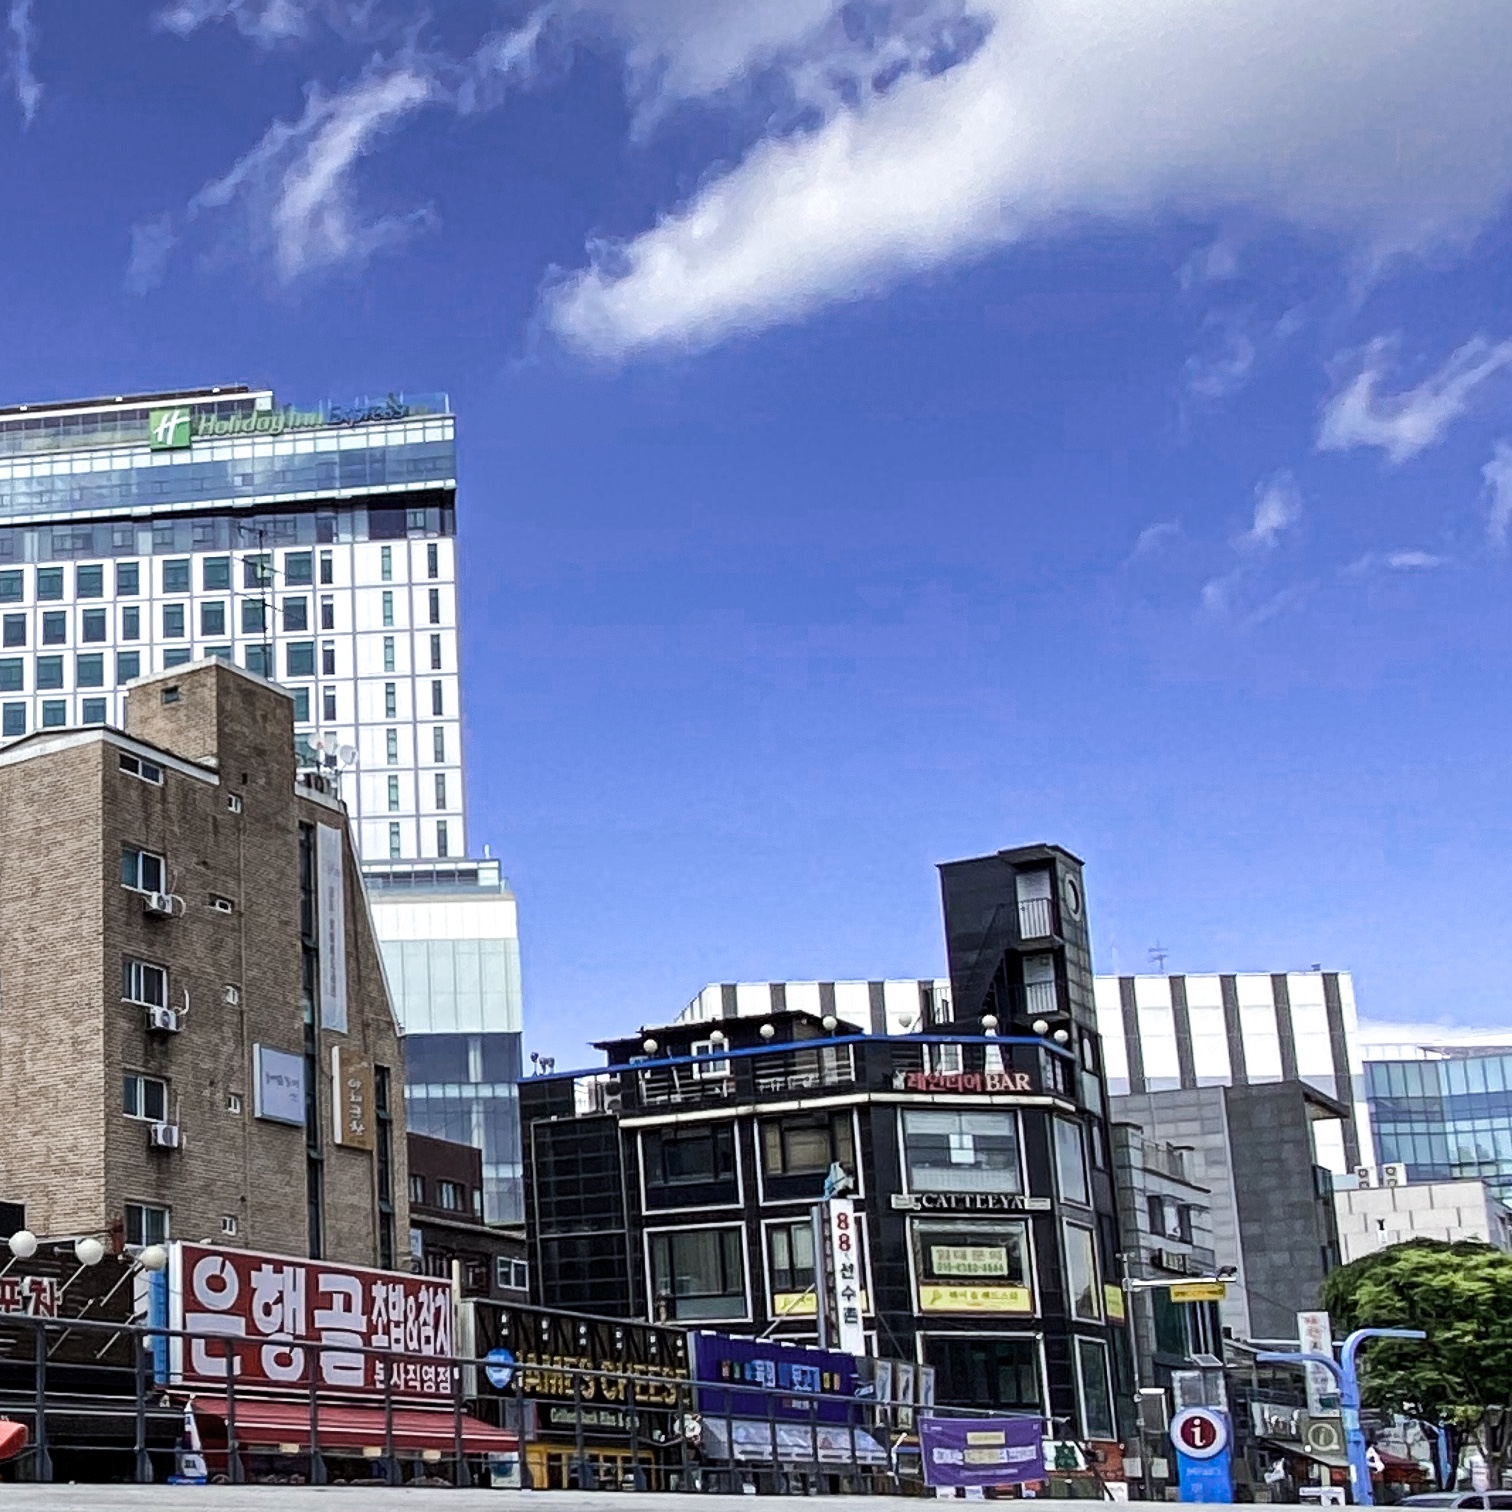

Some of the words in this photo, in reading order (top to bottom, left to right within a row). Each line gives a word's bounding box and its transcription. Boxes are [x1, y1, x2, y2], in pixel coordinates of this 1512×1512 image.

[197, 407, 286, 437] Holiday
[288, 405, 325, 430] Inn
[906, 1071, 982, 1092] 레인디어
[985, 1072, 1032, 1092] BAR
[185, 1255, 367, 1388] 은행골
[371, 1280, 452, 1357] 초밥&참치
